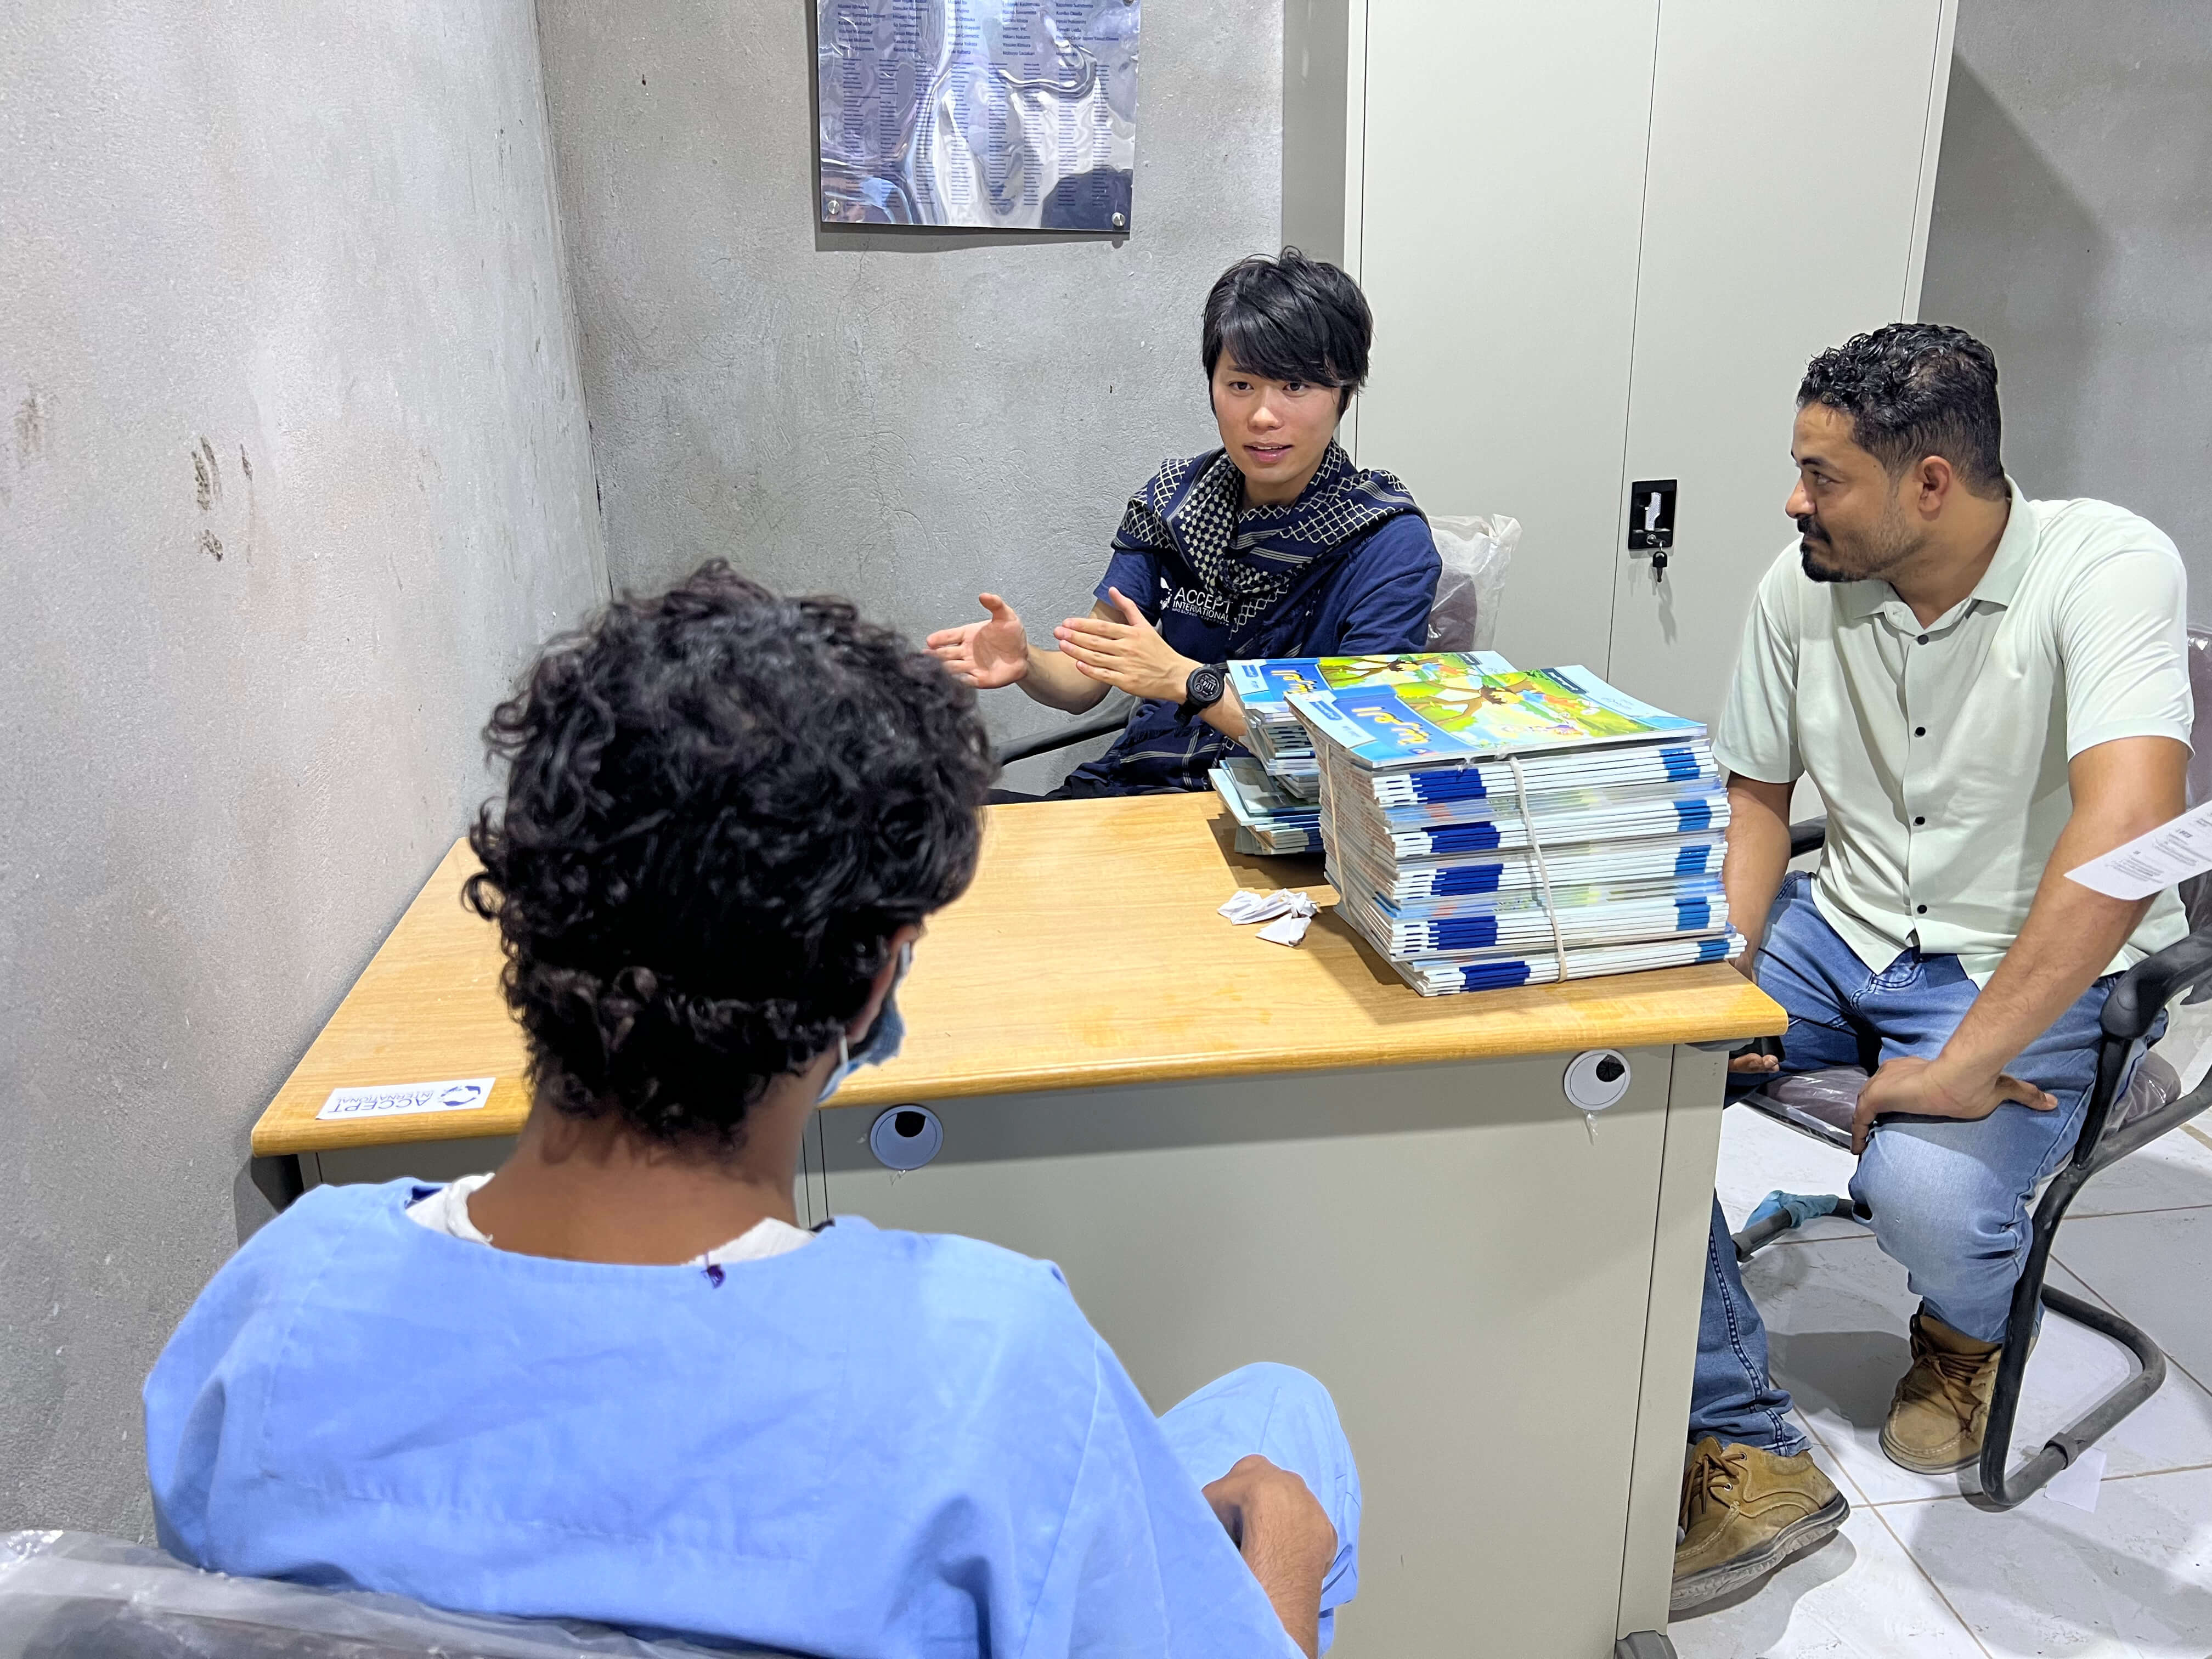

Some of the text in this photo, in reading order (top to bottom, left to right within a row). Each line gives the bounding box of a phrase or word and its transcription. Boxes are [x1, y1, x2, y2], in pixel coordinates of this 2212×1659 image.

[1173, 586, 1232, 614] ACCEPT
[1172, 600, 1229, 623] INTERNATIONAL
[328, 1096, 432, 1113] ACCEPT
[337, 1091, 435, 1103] INTERNATIONAL
